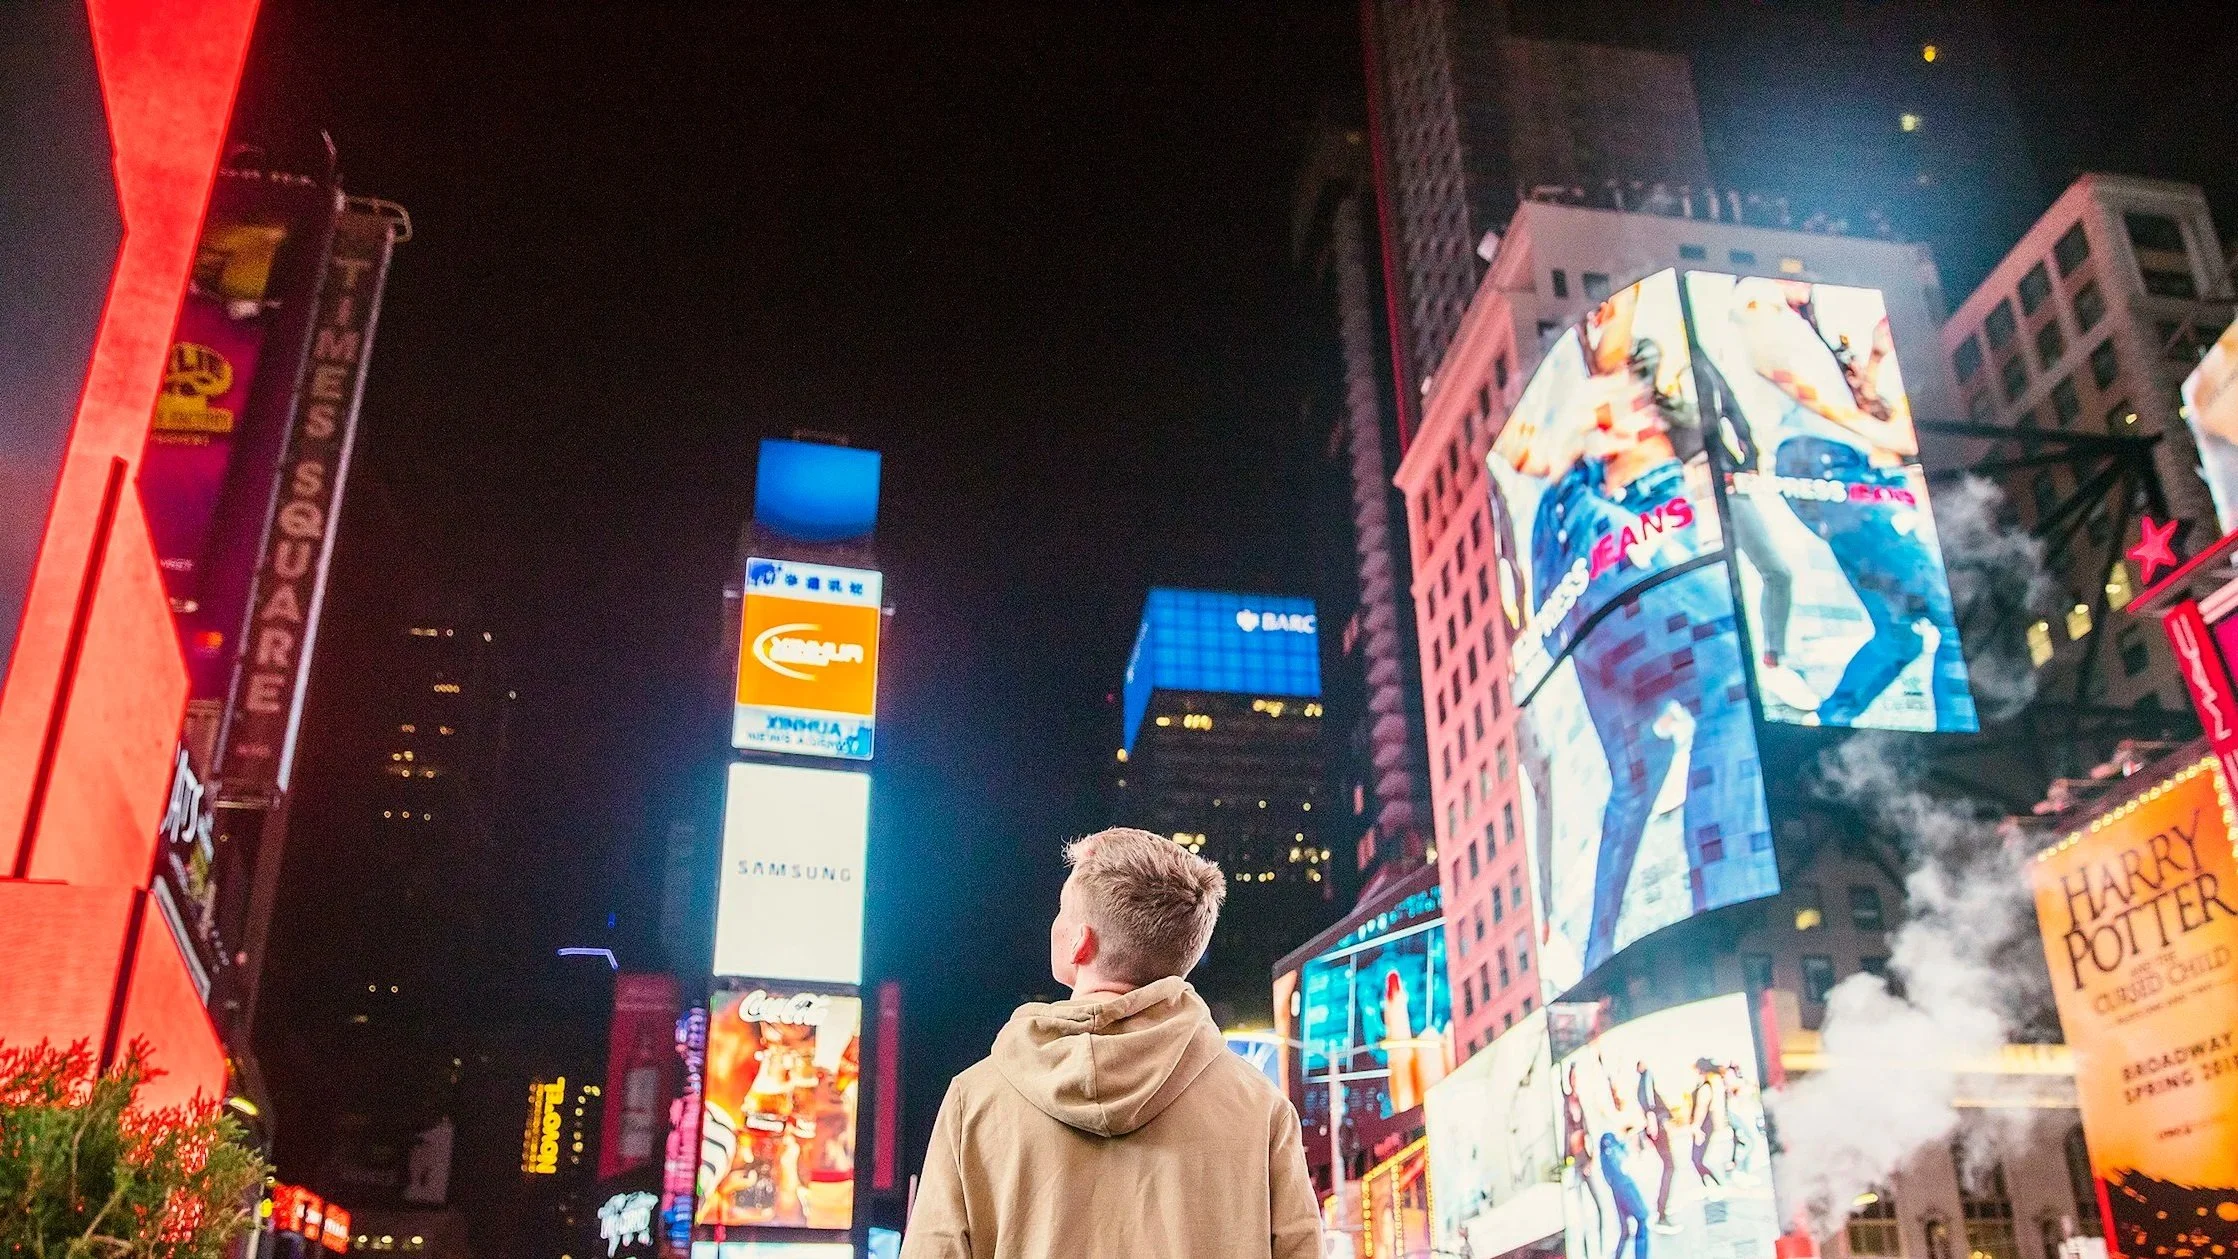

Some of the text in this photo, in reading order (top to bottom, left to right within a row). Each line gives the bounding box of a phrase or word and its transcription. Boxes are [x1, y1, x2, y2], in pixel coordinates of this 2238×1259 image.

[246, 256, 373, 712] TIMES SQUARE
[1590, 497, 1694, 580] JEANS
[1261, 611, 1317, 635] BARC
[738, 860, 851, 882] SAMSUNG
[2060, 807, 2201, 927] HARRY
[2064, 872, 2238, 990] POTTER
[2167, 945, 2231, 986] CHILD
[2121, 1031, 2232, 1083] BROADWAY
[2124, 1068, 2194, 1105] SPRING
[536, 1077, 566, 1174] NOVOTEL
